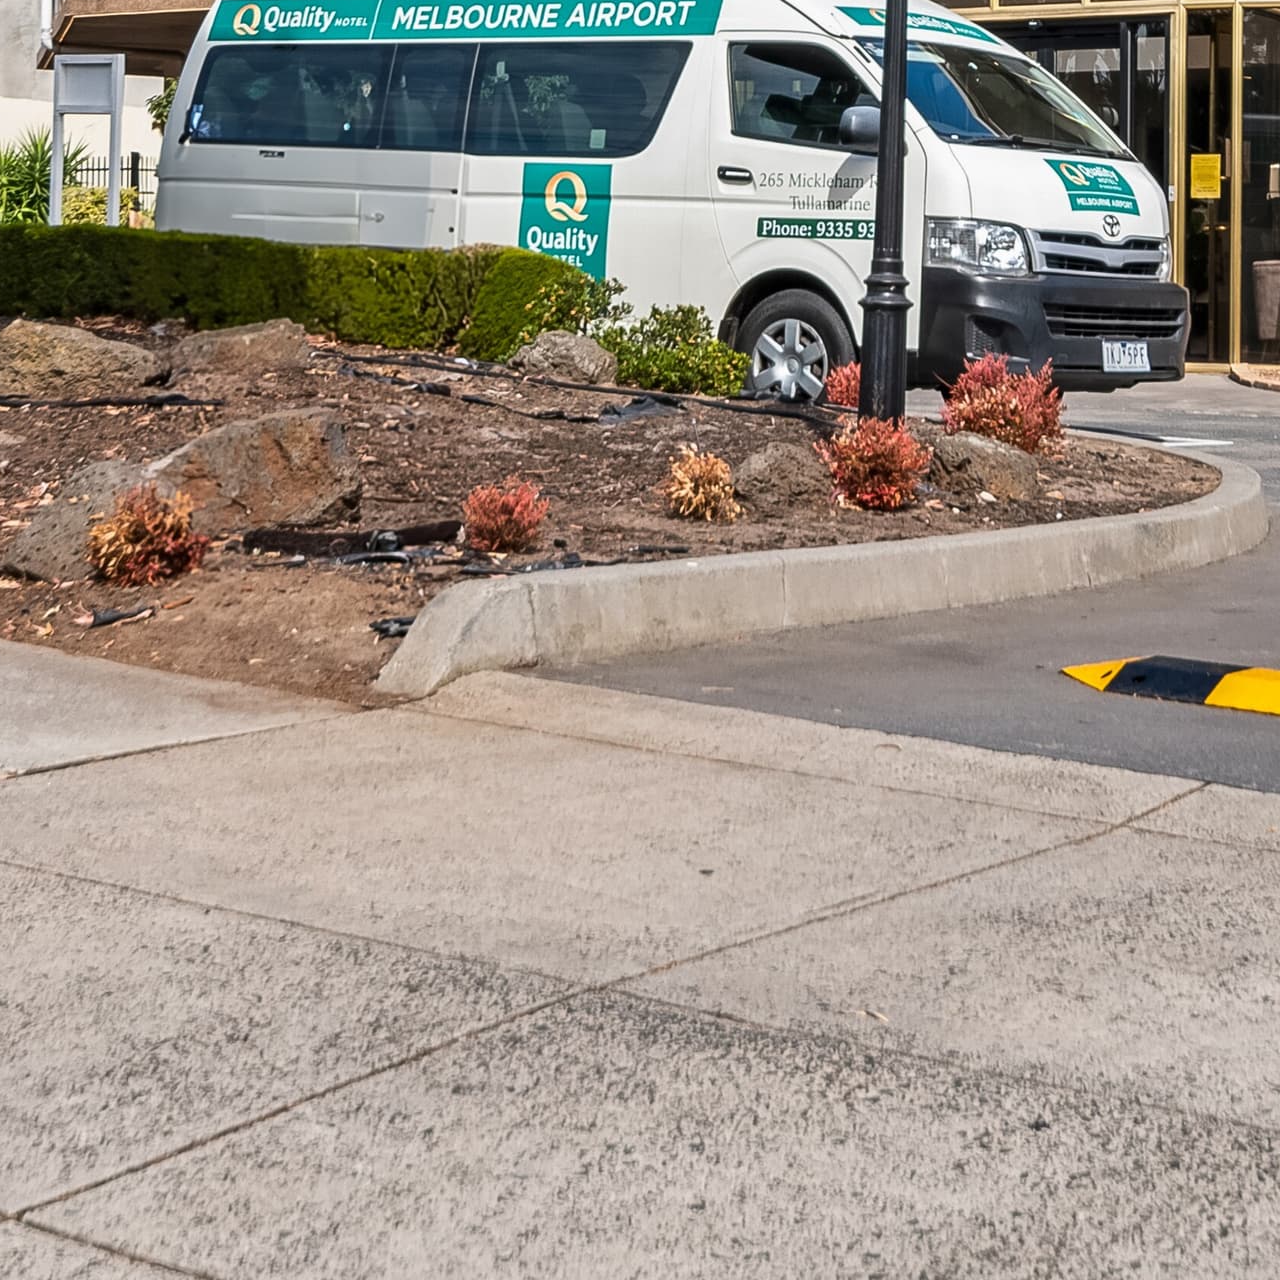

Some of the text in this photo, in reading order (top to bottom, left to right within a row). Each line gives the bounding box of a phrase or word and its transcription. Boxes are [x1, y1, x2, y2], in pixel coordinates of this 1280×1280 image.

[263, 5, 336, 33] Quality
[334, 16, 368, 27] HOTEL
[391, 3, 562, 31] MELBOURNE
[564, 0, 697, 28] AIRPORT
[759, 172, 784, 188] 265
[788, 172, 865, 189] Mickleham
[789, 195, 871, 211] Tullamarine
[762, 219, 812, 237] Phone:
[816, 221, 853, 238] 9335
[526, 226, 599, 257] Quality
